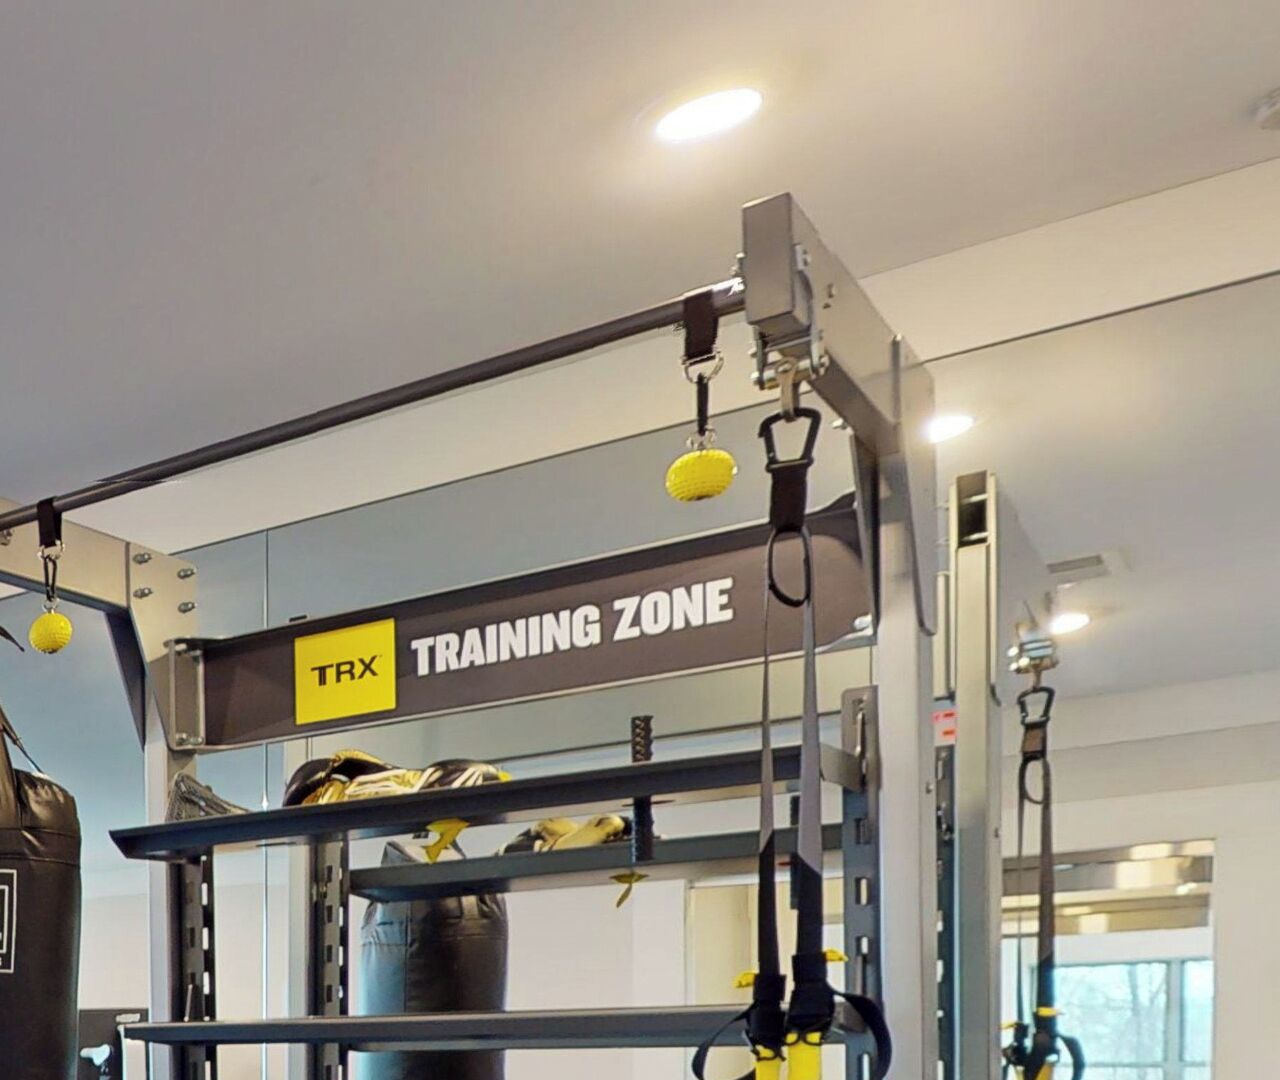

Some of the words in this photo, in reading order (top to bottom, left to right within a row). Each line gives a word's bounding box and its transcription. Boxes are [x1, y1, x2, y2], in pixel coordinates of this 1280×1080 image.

[410, 604, 601, 677] TRAINING
[612, 576, 734, 642] ZONE
[311, 655, 378, 687] TRX
